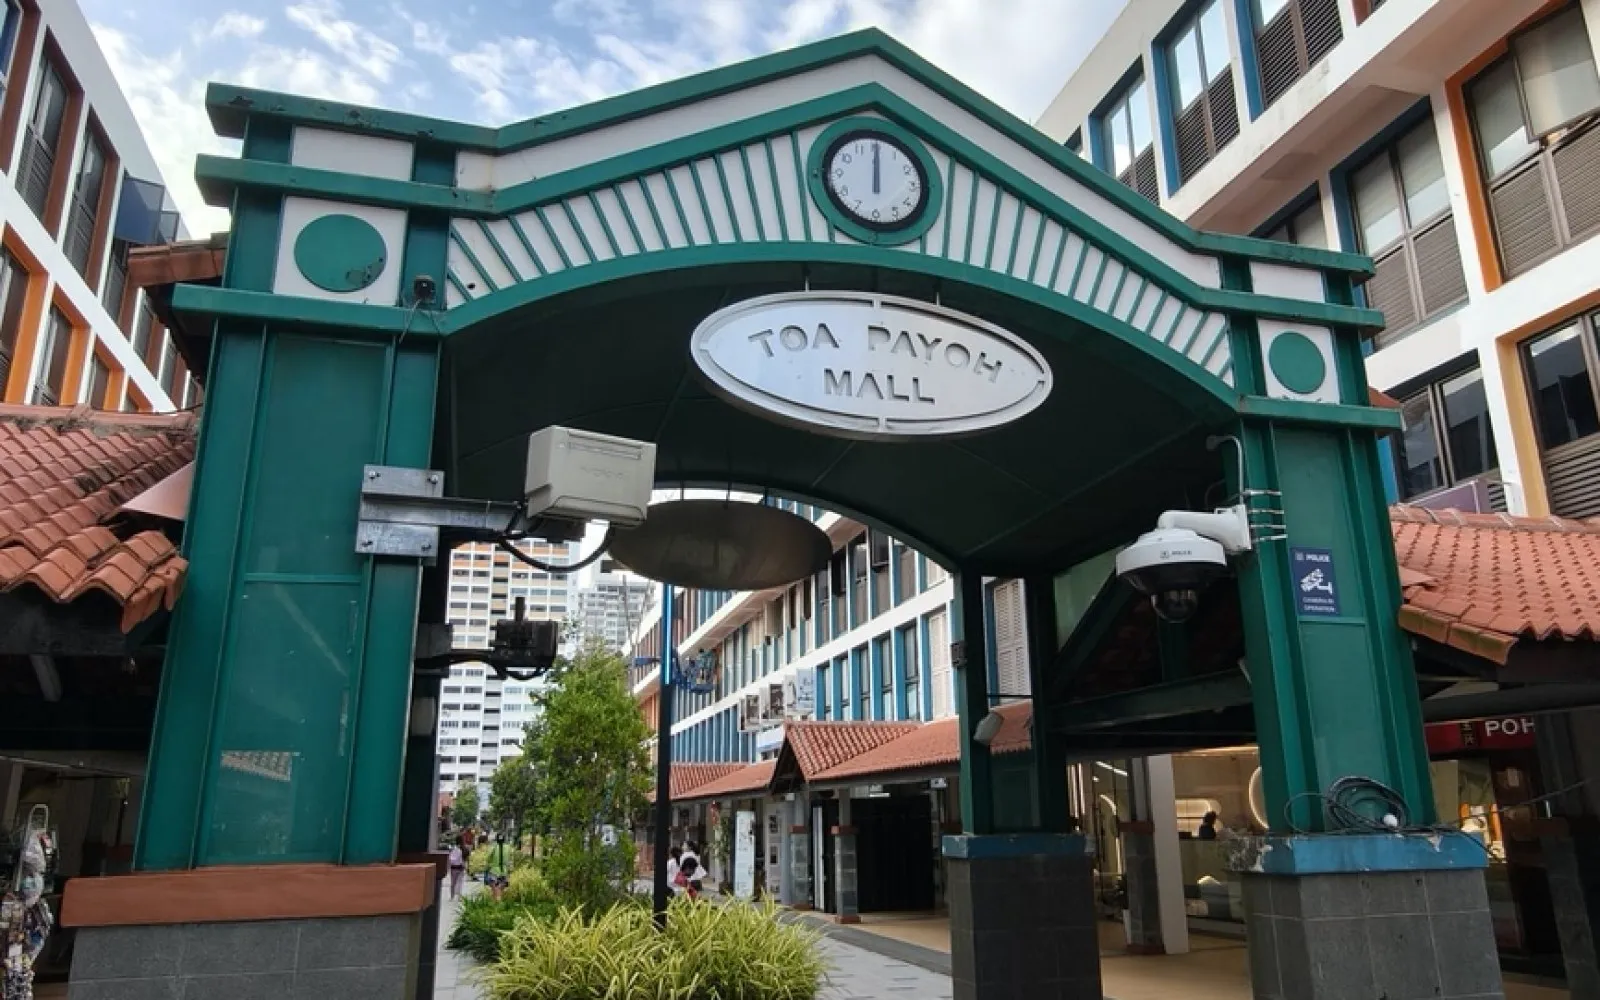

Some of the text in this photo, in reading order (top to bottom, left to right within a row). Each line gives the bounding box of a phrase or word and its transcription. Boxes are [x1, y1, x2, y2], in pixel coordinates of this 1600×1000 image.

[748, 323, 1002, 385] TOA PAYOH
[824, 367, 936, 405] MALL
